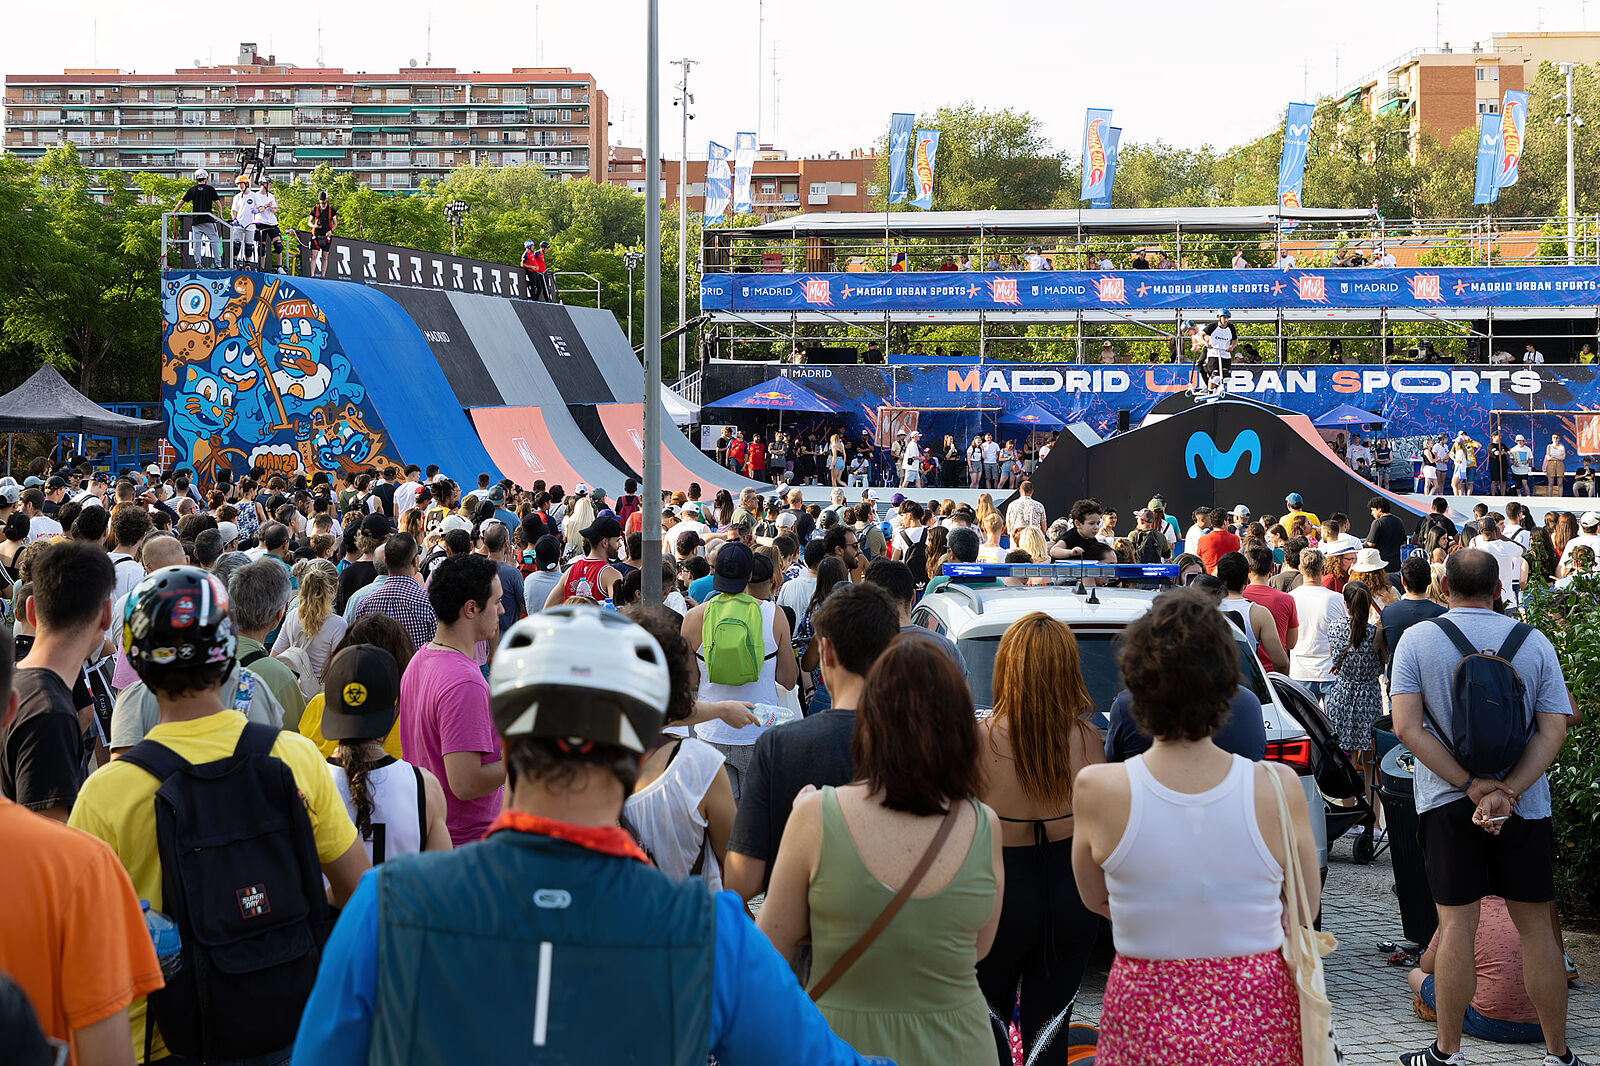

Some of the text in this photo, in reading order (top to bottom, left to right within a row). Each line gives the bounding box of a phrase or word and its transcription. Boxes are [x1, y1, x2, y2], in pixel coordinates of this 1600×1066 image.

[856, 286, 966, 296] MADRID URBAN SPORTS
[1044, 286, 1086, 295] MADRID
[1153, 284, 1270, 294] MADRID URBAN SPORTS
[1354, 283, 1399, 292] MADRID
[1471, 281, 1596, 292] MADRID URBAN SPORTS
[700, 287, 724, 296] DRID
[754, 287, 793, 296] MADRID
[278, 304, 308, 318] SCOOT
[792, 369, 833, 378] MADRID
[947, 370, 1542, 394] MADRID UBAN SPORTS
[770, 399, 794, 407] Bull
[255, 452, 298, 472] MANZA
